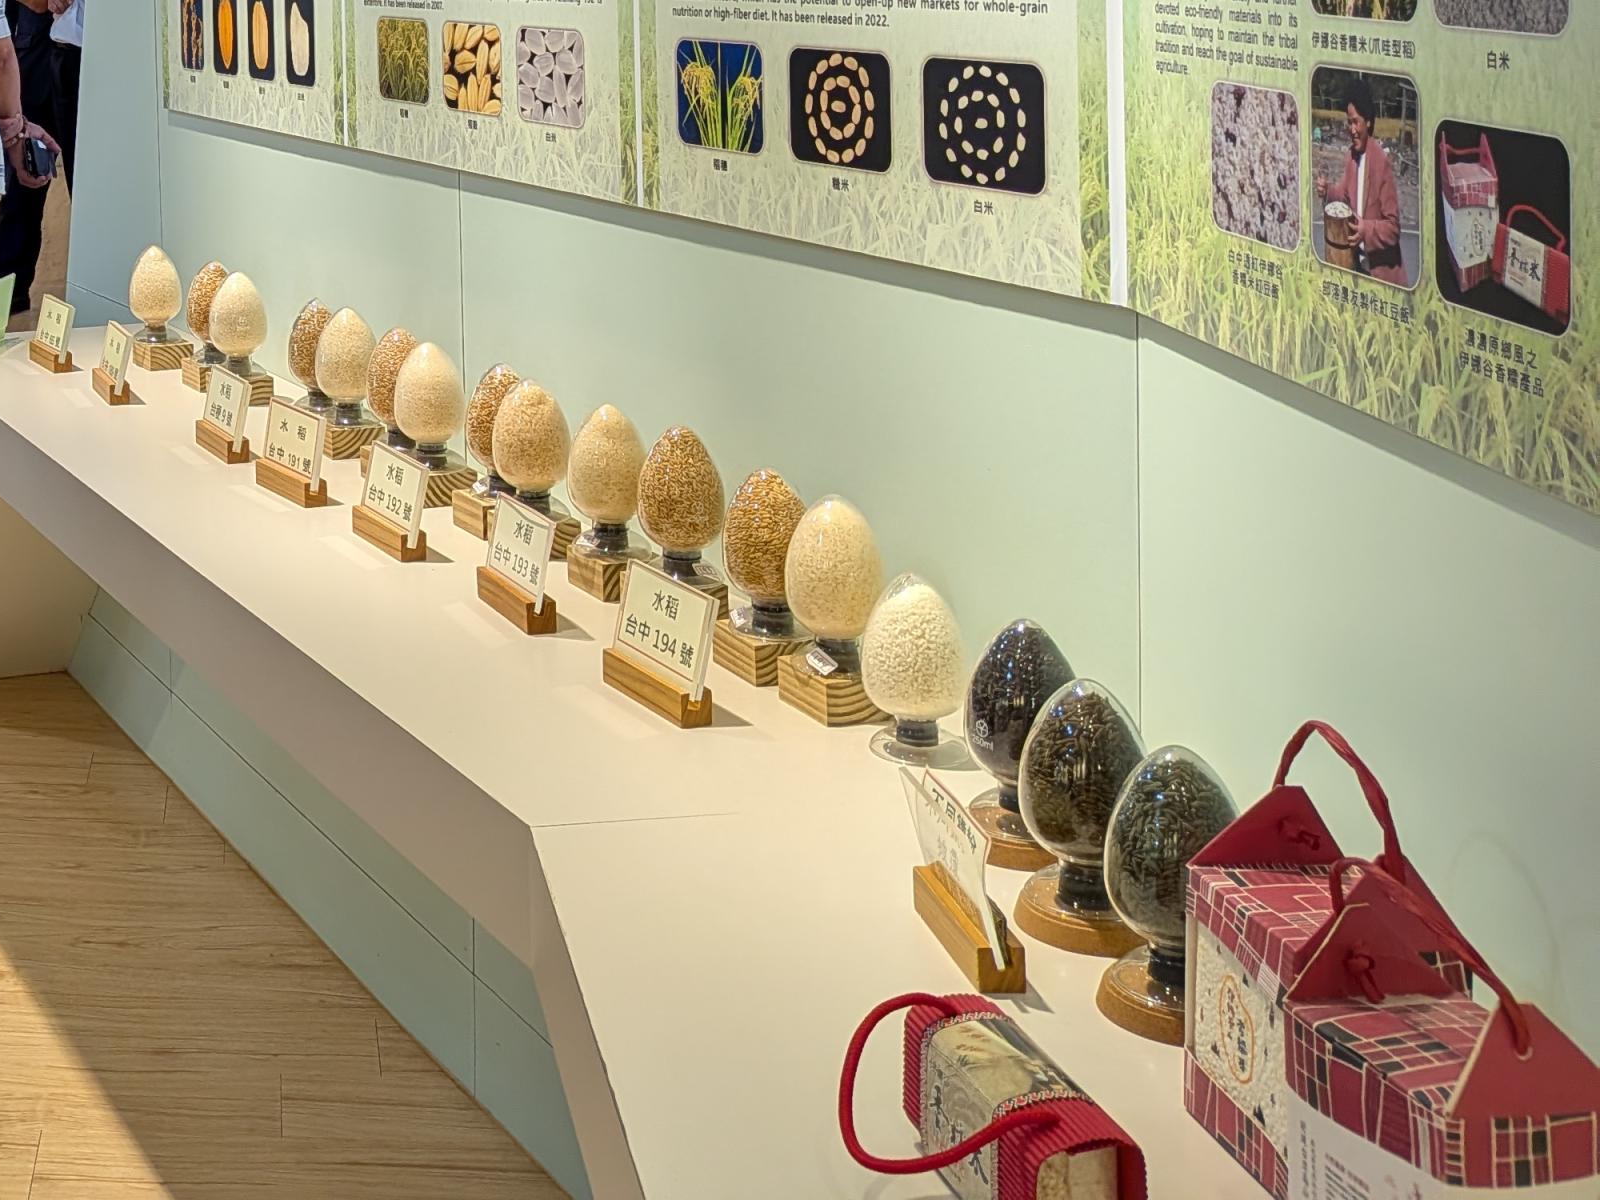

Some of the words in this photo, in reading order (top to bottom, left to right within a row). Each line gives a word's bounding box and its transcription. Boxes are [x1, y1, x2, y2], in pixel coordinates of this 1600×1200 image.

[1486, 49, 1510, 71] 白米
[972, 198, 994, 215] 白米
[219, 381, 232, 400] 水稻
[385, 462, 405, 487] 水稻
[512, 519, 534, 546] 水稻
[651, 589, 680, 621] 水稻
[972, 734, 994, 751] 250ml
